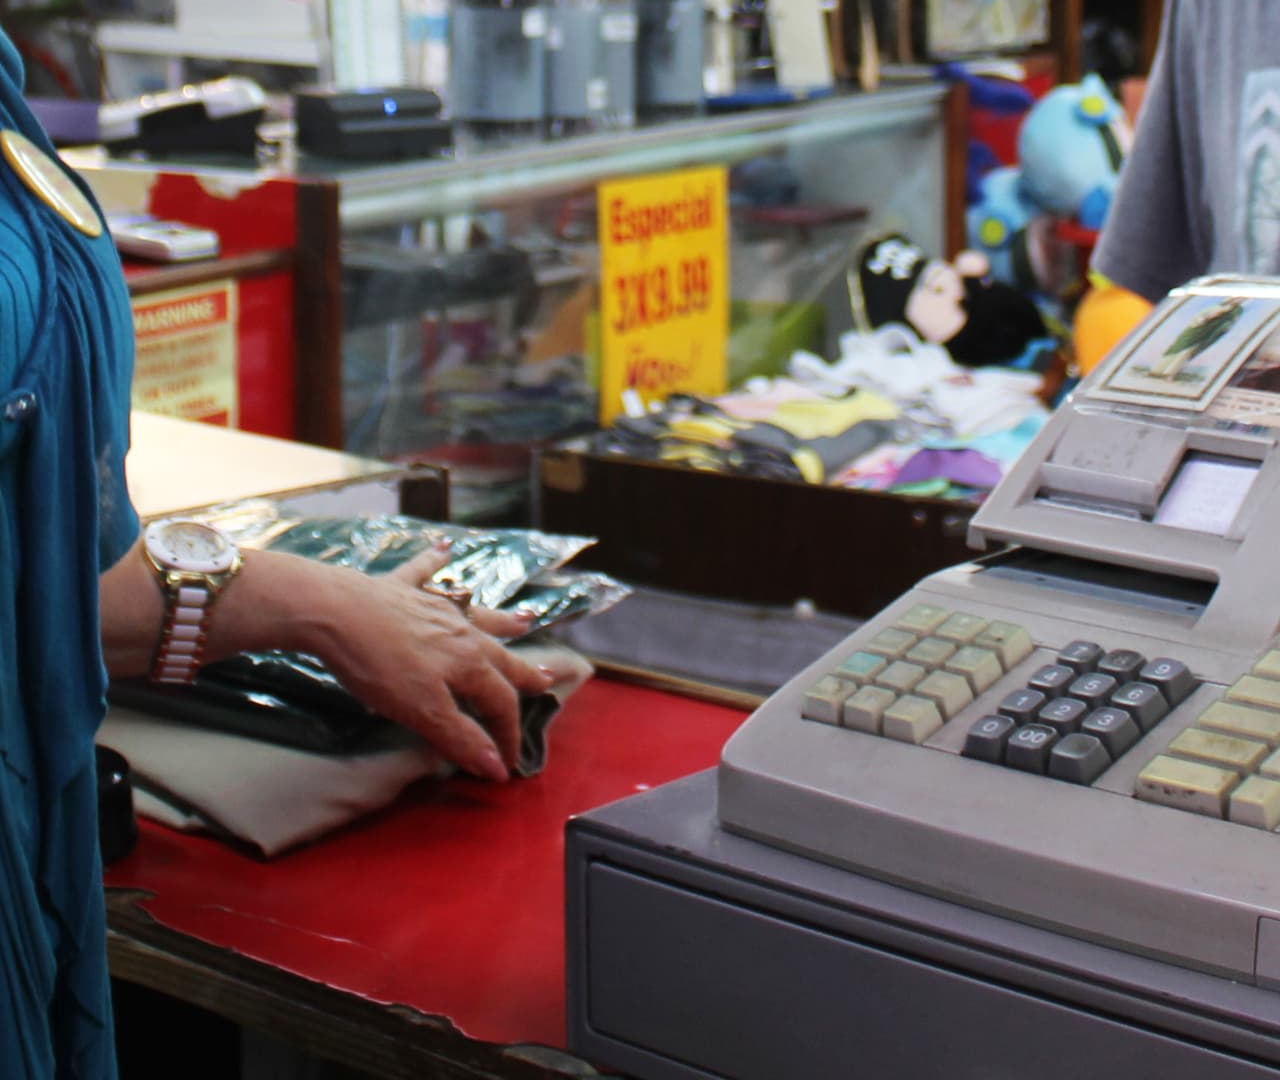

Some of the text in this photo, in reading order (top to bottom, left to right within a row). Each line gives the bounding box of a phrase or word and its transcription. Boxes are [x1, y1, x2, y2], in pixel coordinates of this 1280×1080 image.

[611, 184, 712, 246] Especial
[614, 255, 710, 335] 3X9.99
[1154, 664, 1171, 675] 9
[1042, 671, 1057, 681] 4
[1084, 680, 1100, 691] 5
[1127, 688, 1144, 700] 6
[1017, 695, 1027, 706] 1
[1053, 705, 1071, 716] 2
[981, 720, 999, 732] 0
[1096, 714, 1115, 726] 3
[1019, 728, 1047, 743] 00
